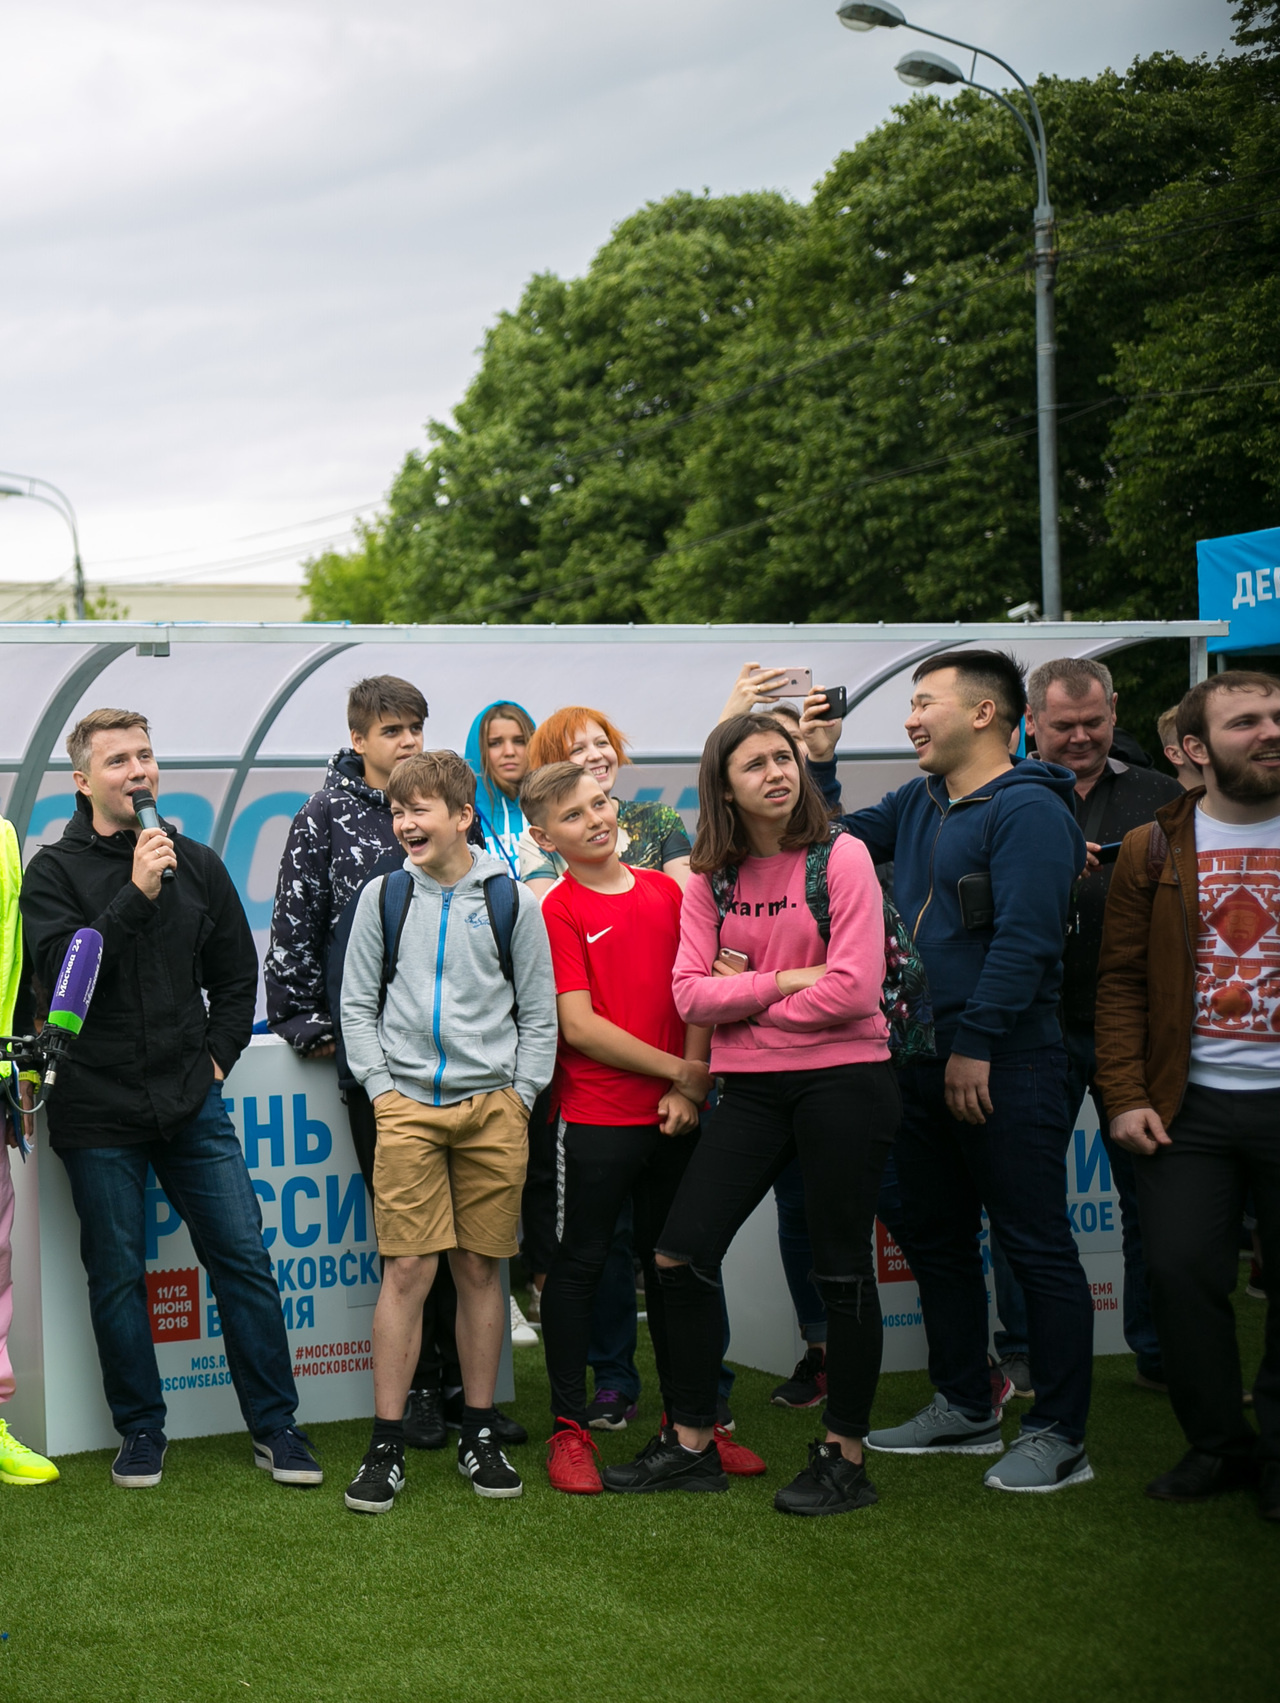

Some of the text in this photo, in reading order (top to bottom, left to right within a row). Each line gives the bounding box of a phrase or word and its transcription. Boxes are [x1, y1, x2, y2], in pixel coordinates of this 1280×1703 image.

[58, 954, 77, 998] Москва
[72, 938, 83, 953] 24
[887, 1258, 911, 1272] 201
[157, 1284, 188, 1299] 11/12
[153, 1300, 192, 1316] ИЮНЯ
[158, 1315, 189, 1331] 2018
[882, 1312, 923, 1328] MOSCOW
[295, 1339, 371, 1361] #МОСКОВСКО
[191, 1354, 226, 1371] MOS.R
[292, 1356, 374, 1378] #МОСКОВСКИЕ
[160, 1371, 232, 1392] OSCOWSEASO
